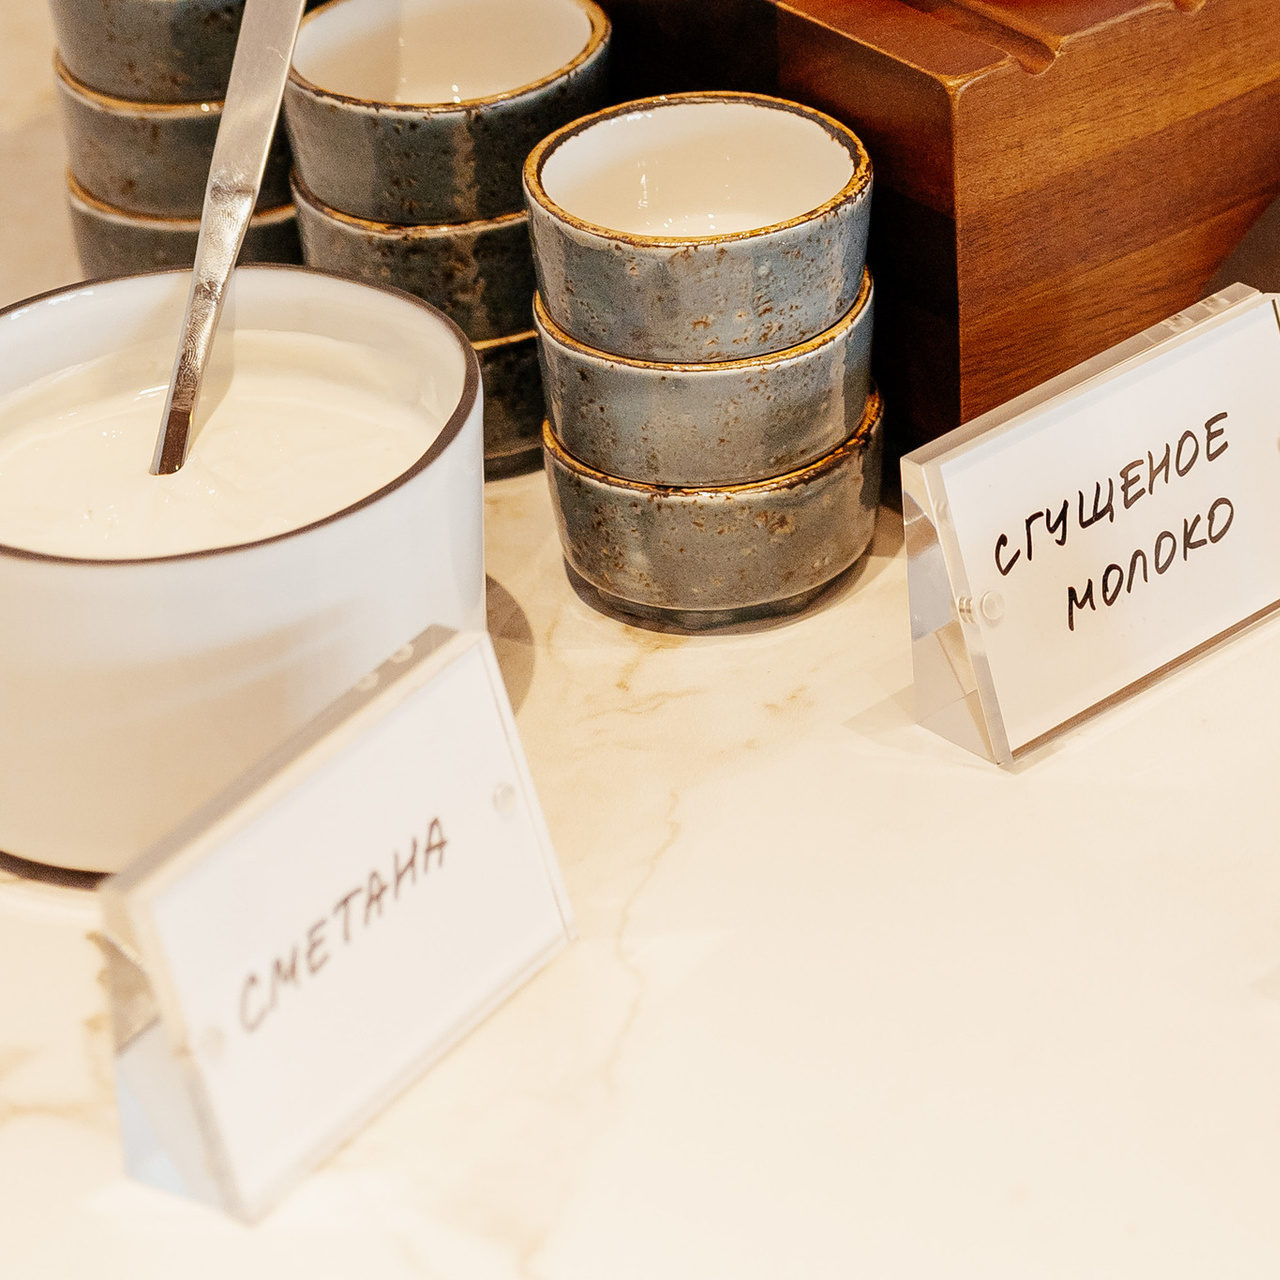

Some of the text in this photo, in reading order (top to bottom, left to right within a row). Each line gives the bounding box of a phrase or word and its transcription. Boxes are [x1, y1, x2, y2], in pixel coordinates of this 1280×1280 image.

[993, 410, 1230, 577] СГУЩЕНОЕ
[1066, 496, 1236, 632] МОЛОКО
[238, 815, 449, 1034] СМЕТАНА
